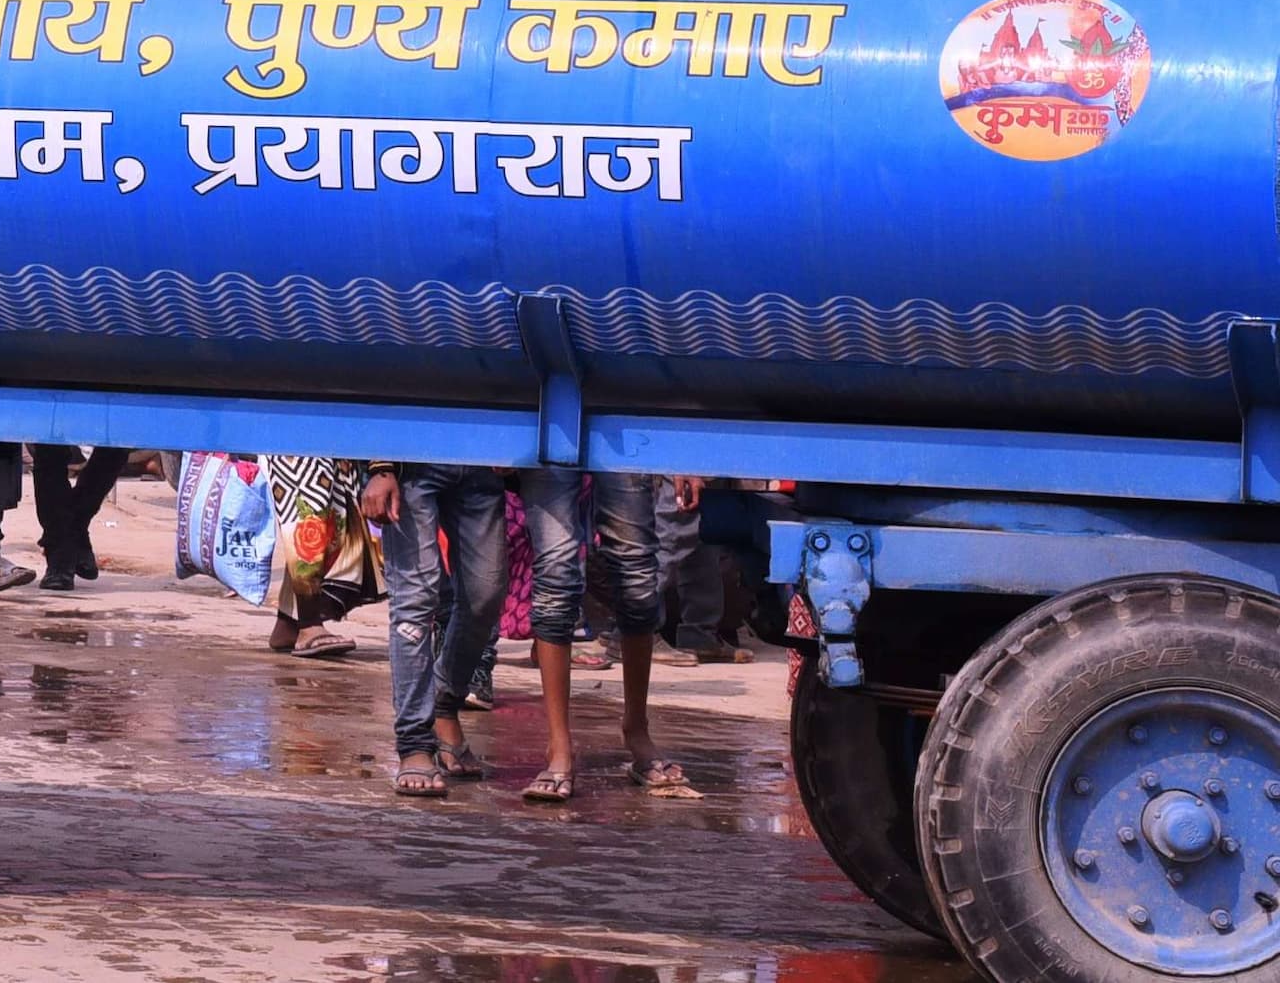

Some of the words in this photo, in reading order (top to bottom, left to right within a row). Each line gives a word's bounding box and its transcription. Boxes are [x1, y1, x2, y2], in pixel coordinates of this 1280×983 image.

[179, 111, 694, 203] प्रयागराज
[973, 102, 1090, 145] कुम्भ
[1066, 111, 1109, 125] 2019
